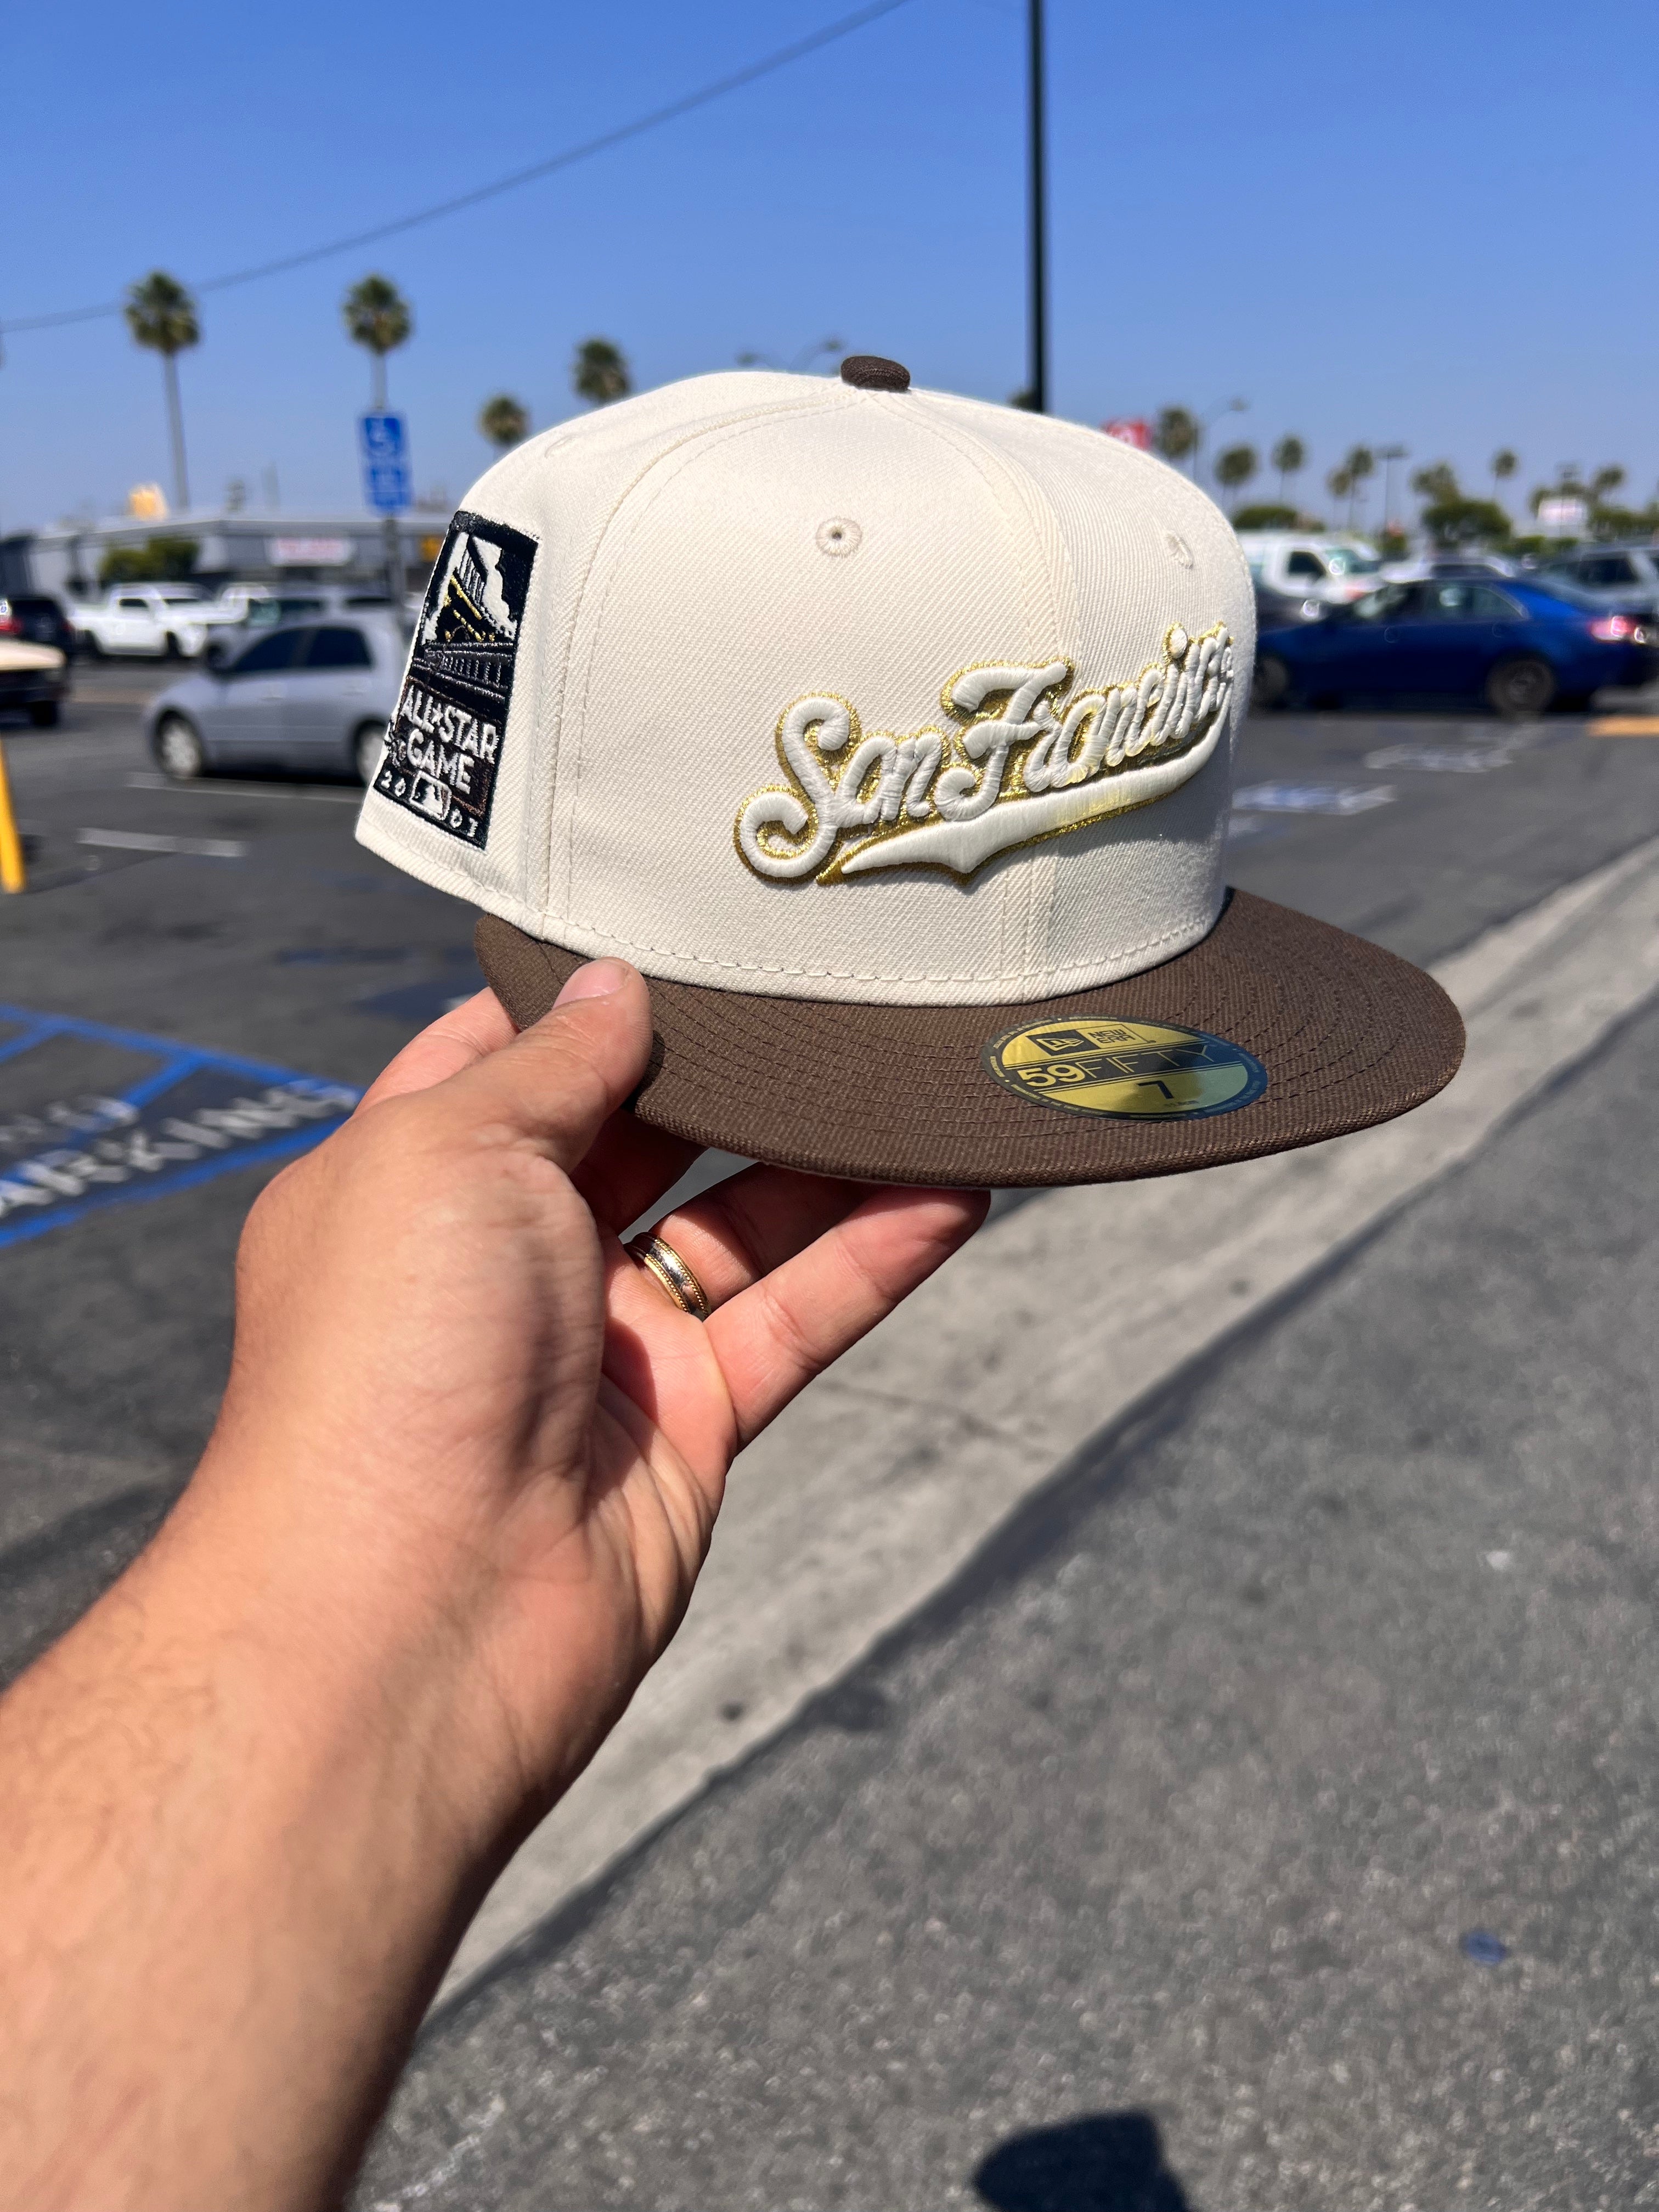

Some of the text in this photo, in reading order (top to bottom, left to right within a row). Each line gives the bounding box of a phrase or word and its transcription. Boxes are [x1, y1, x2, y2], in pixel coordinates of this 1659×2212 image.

[407, 729, 475, 794] GAME
[734, 691, 950, 882] San
[1087, 1029, 1127, 1039] NEW
[1097, 1034, 1136, 1044] ERA
[1017, 1045, 1214, 1088] 59FIFTY
[1137, 1081, 1174, 1099] 7
